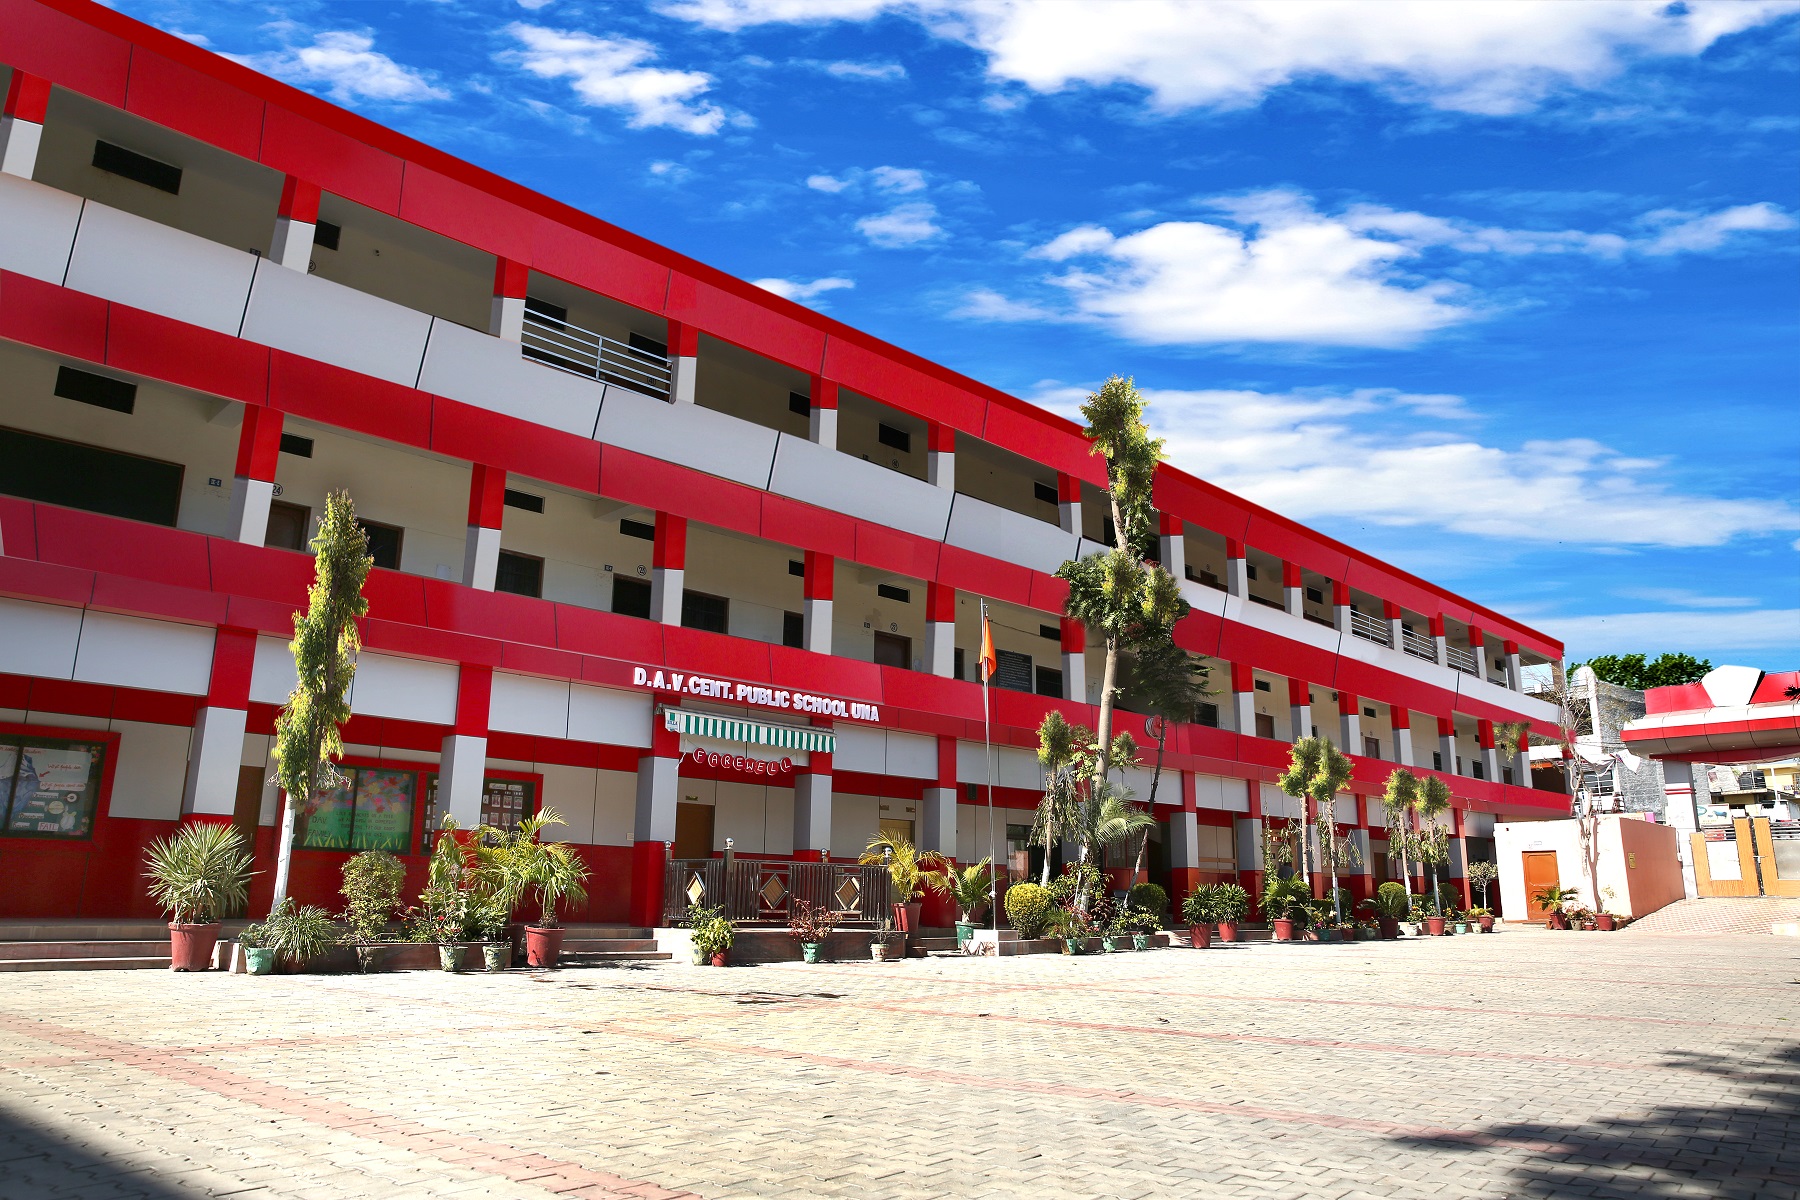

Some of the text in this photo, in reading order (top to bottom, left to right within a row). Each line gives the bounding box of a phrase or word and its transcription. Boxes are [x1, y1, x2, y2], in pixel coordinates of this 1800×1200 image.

[272, 485, 281, 495] 24
[736, 684, 790, 709] PUBLIC
[792, 693, 849, 718] SCHOOL
[851, 702, 880, 722] UNA
[695, 750, 792, 774] FAREWELL
